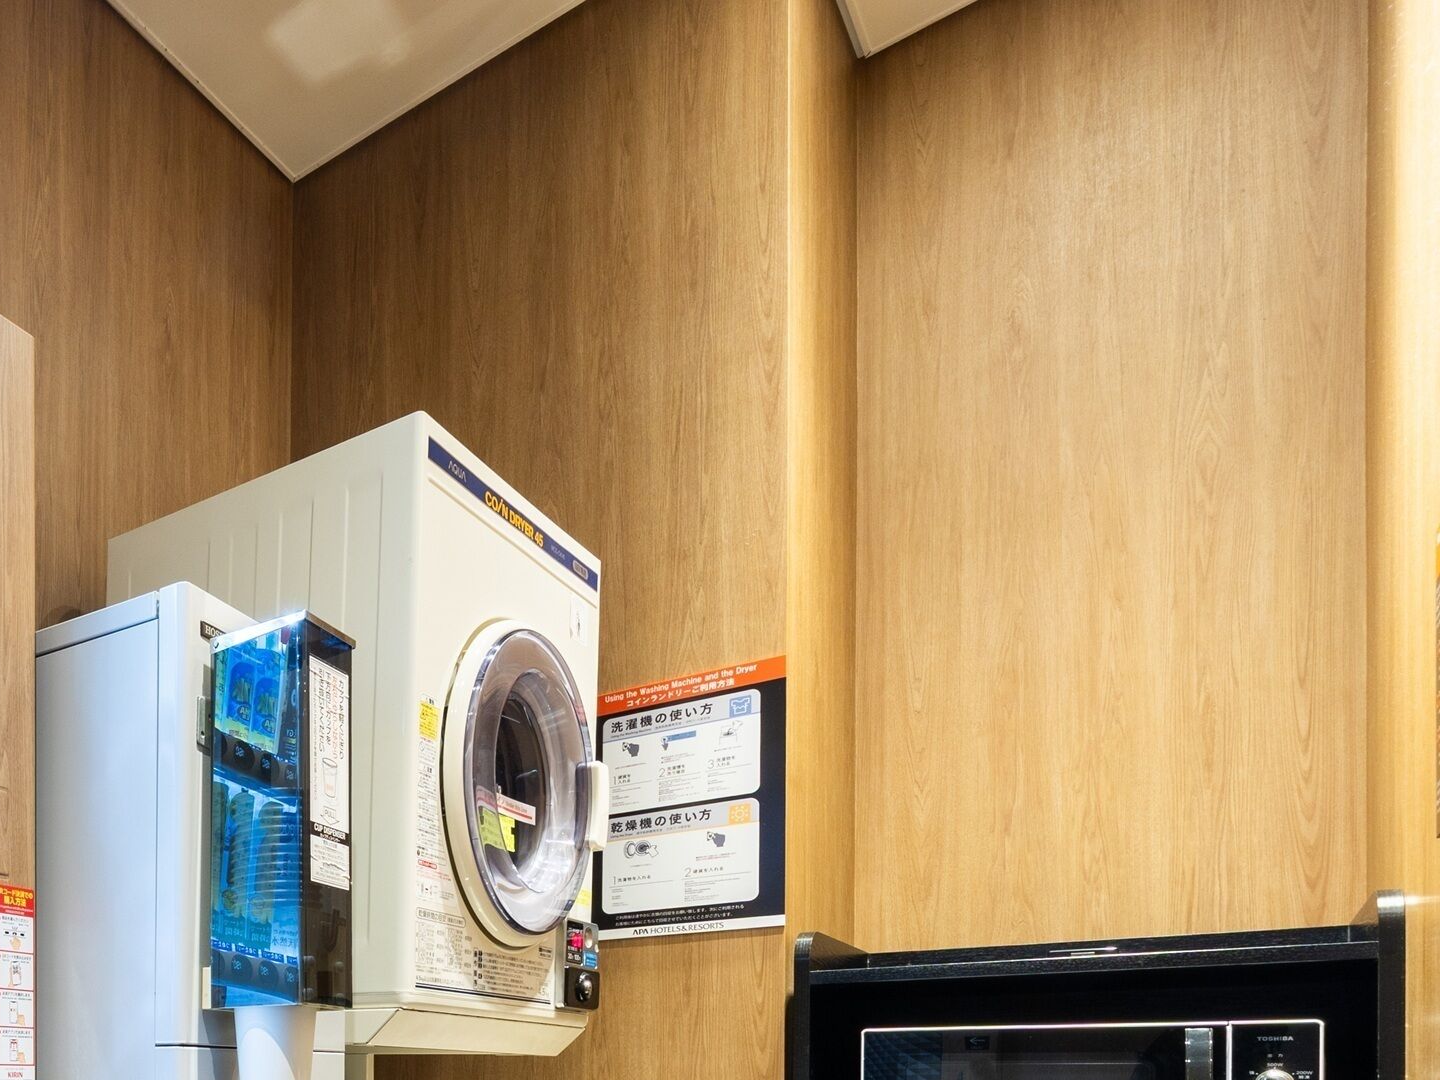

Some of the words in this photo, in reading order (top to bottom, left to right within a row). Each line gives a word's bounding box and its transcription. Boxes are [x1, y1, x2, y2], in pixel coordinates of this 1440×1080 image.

[509, 509, 535, 540] DRYER
[534, 531, 544, 548] 45
[604, 693, 625, 704] Using
[626, 689, 639, 700] the
[639, 683, 670, 698] Washing
[671, 676, 703, 690] Machine
[704, 672, 718, 684] and
[720, 669, 734, 681] the
[735, 663, 758, 678] Dryer
[626, 678, 735, 708] コインランドリーご利用方法
[611, 703, 714, 734] 洗濯機の使い方
[659, 768, 665, 778] 2
[707, 758, 714, 770] 3
[610, 809, 712, 834] 乾燥機の使い方
[684, 867, 691, 877] 2
[632, 928, 649, 936] APA
